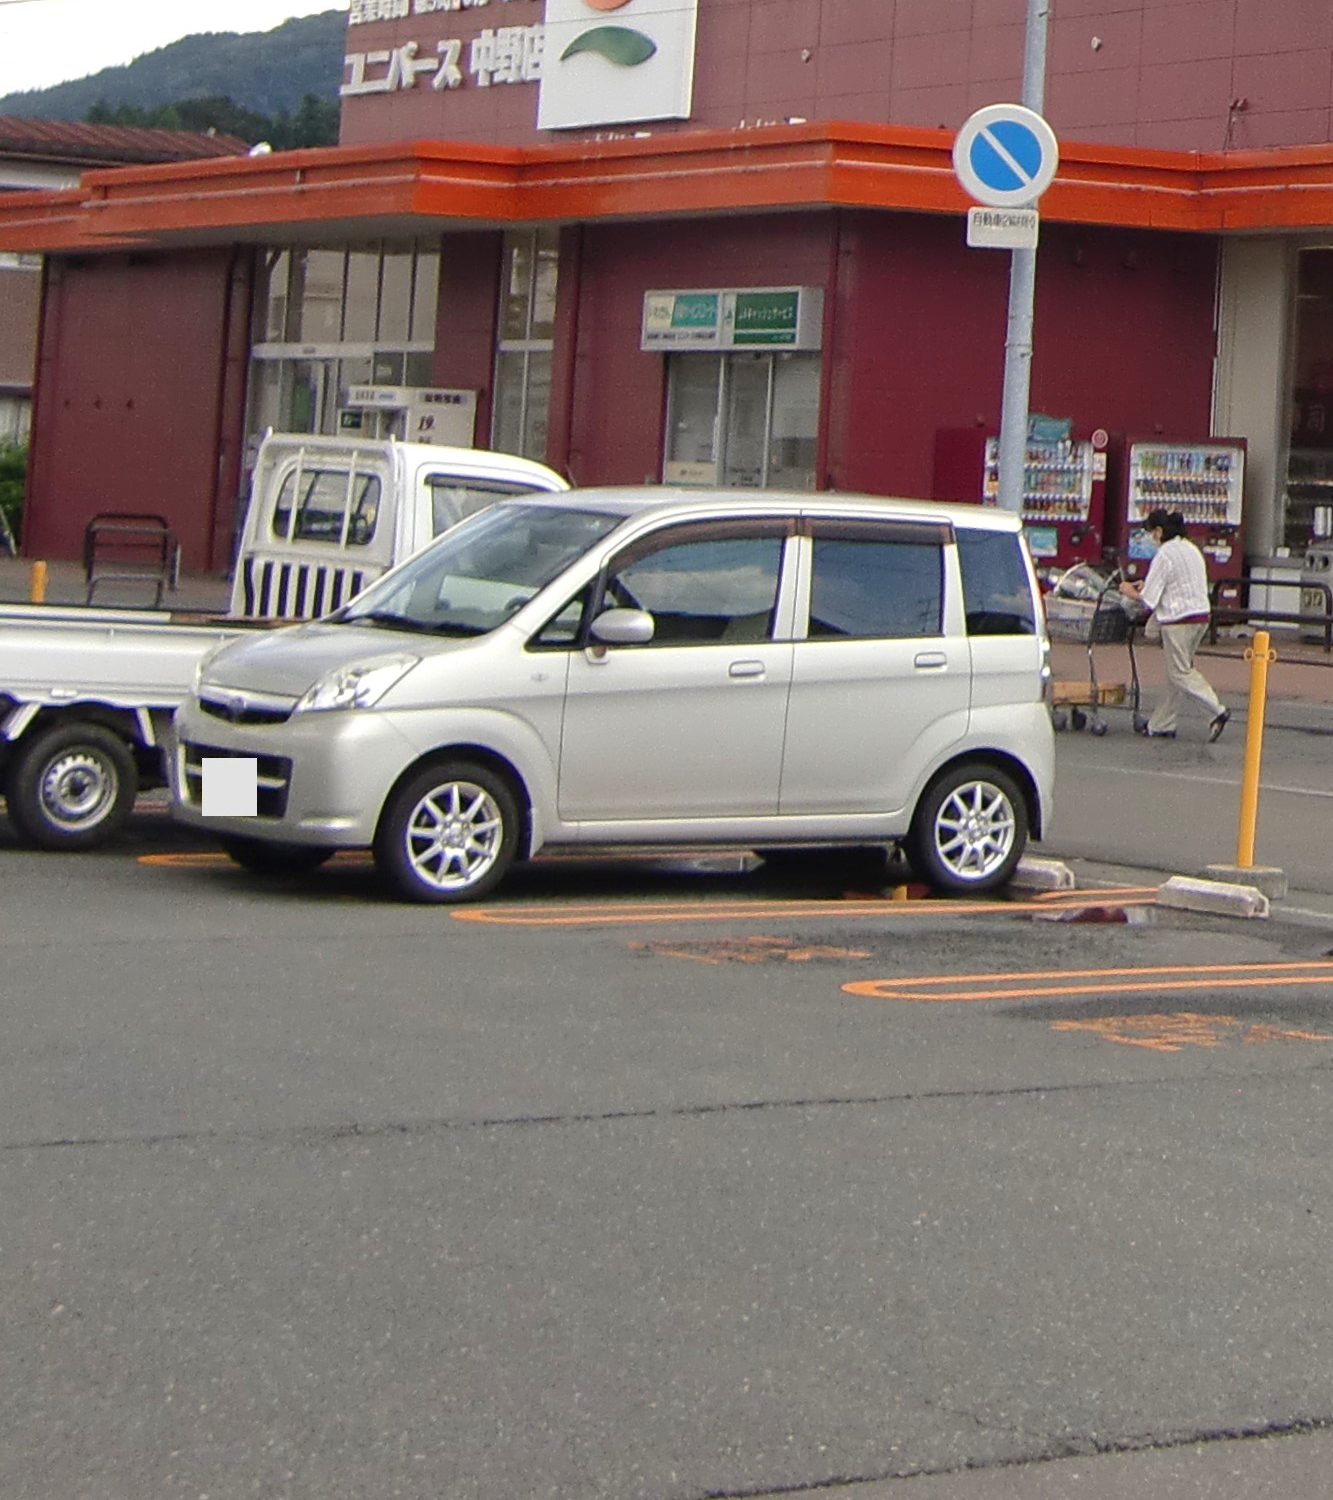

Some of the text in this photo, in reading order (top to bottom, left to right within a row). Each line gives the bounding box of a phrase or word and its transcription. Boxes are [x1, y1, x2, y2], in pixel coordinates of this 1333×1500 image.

[339, 40, 462, 97] ユニバース
